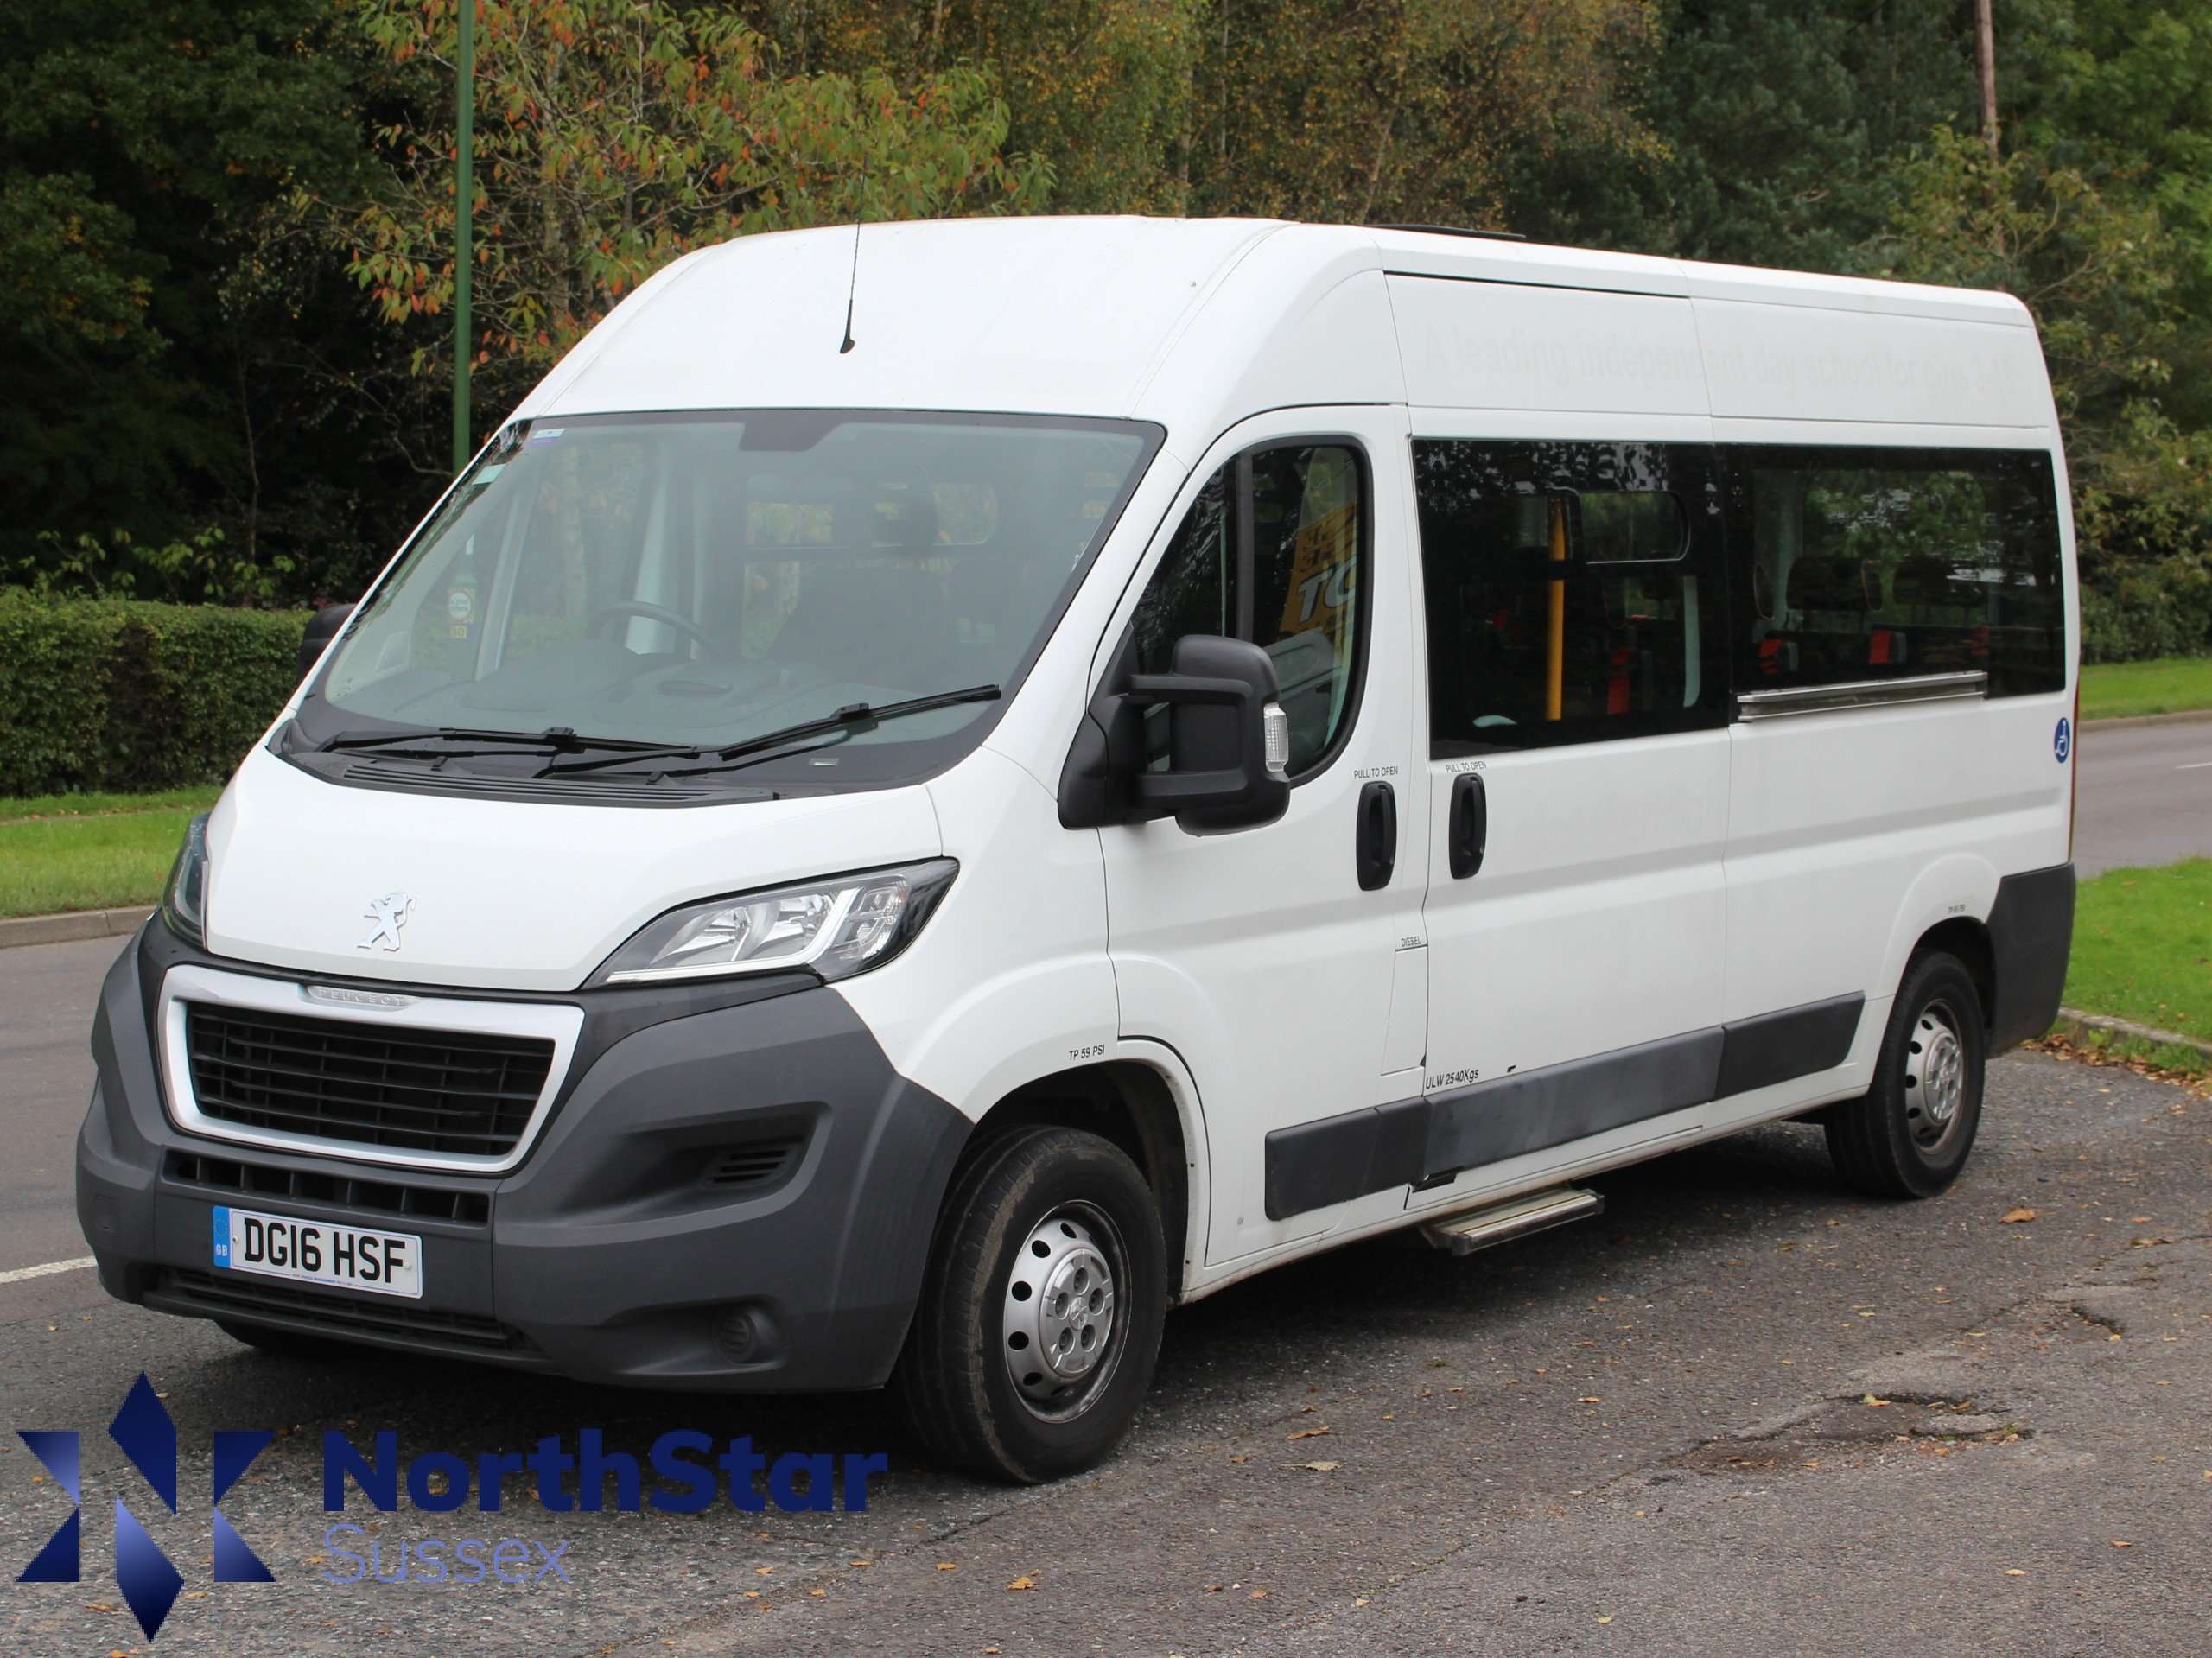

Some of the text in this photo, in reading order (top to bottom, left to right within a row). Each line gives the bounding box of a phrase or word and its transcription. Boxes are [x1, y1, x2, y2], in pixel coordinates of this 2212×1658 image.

[1354, 765, 1398, 779] PULL TO OPEN
[1445, 760, 1486, 773] PULL TO OPEN
[1401, 935, 1421, 947] DIESEL
[1069, 1044, 1105, 1061] TP 59 PSI
[1426, 1074, 1445, 1089] ULW
[216, 1244, 229, 1257] GB
[244, 1217, 406, 1284] DG16 HSF
